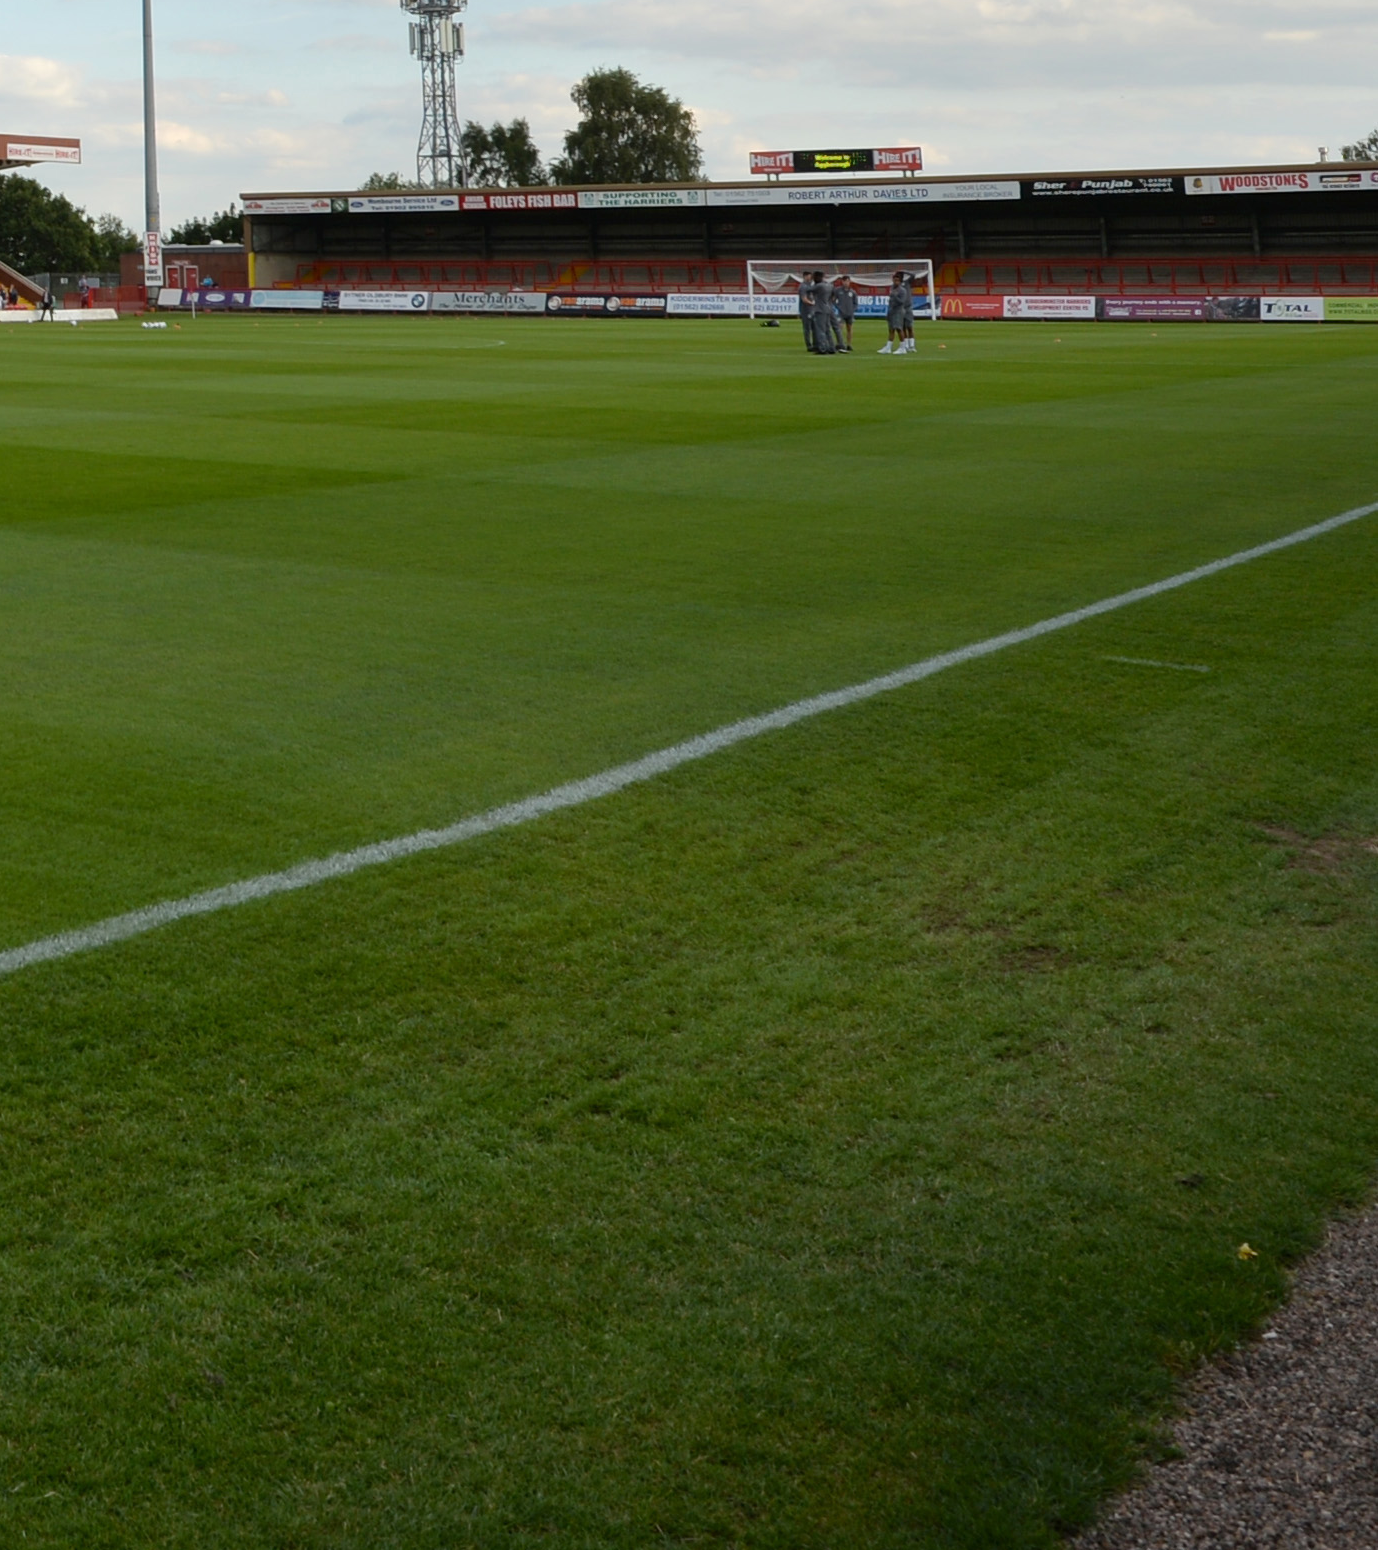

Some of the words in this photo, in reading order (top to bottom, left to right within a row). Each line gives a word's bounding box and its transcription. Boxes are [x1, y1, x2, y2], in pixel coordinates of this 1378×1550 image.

[751, 154, 775, 167] HIRE
[776, 152, 794, 167] IT!
[873, 150, 901, 165] HIRE
[902, 149, 921, 164] IT!
[1034, 181, 1066, 190] Sher
[1082, 179, 1132, 190] Punjab
[1220, 174, 1309, 192] WOODSTONES
[490, 195, 526, 208] FOLEYS
[528, 195, 552, 208] FISH
[553, 194, 575, 207] BAR
[789, 191, 825, 200] ROBERT
[829, 190, 868, 199] ARTHUR
[873, 189, 907, 199] DAVIES
[911, 188, 928, 198] LTD
[453, 293, 525, 303] Merchants
